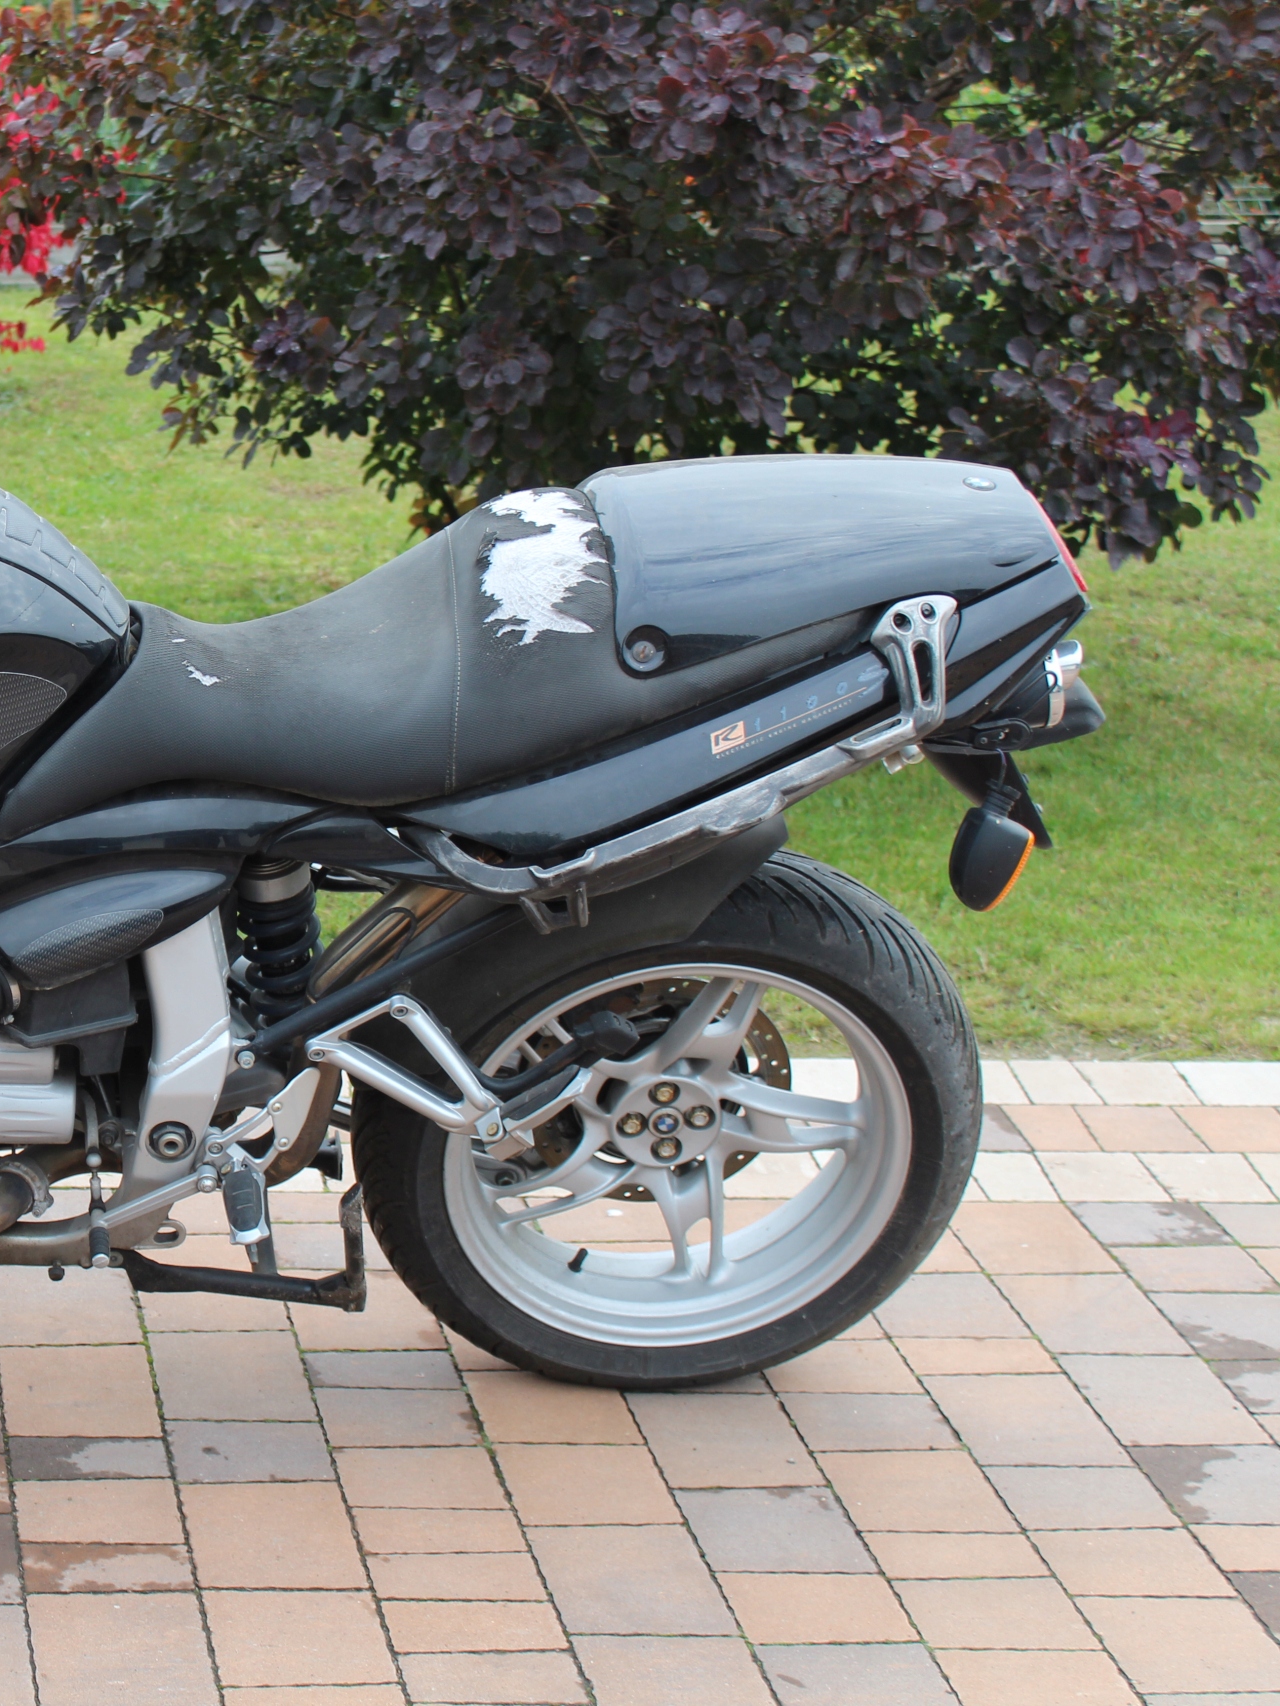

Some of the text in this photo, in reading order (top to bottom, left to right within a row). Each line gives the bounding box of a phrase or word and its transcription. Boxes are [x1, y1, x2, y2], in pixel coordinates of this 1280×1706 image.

[716, 699, 853, 760] ELECTRONIC ENGINE MANAGEMENT
